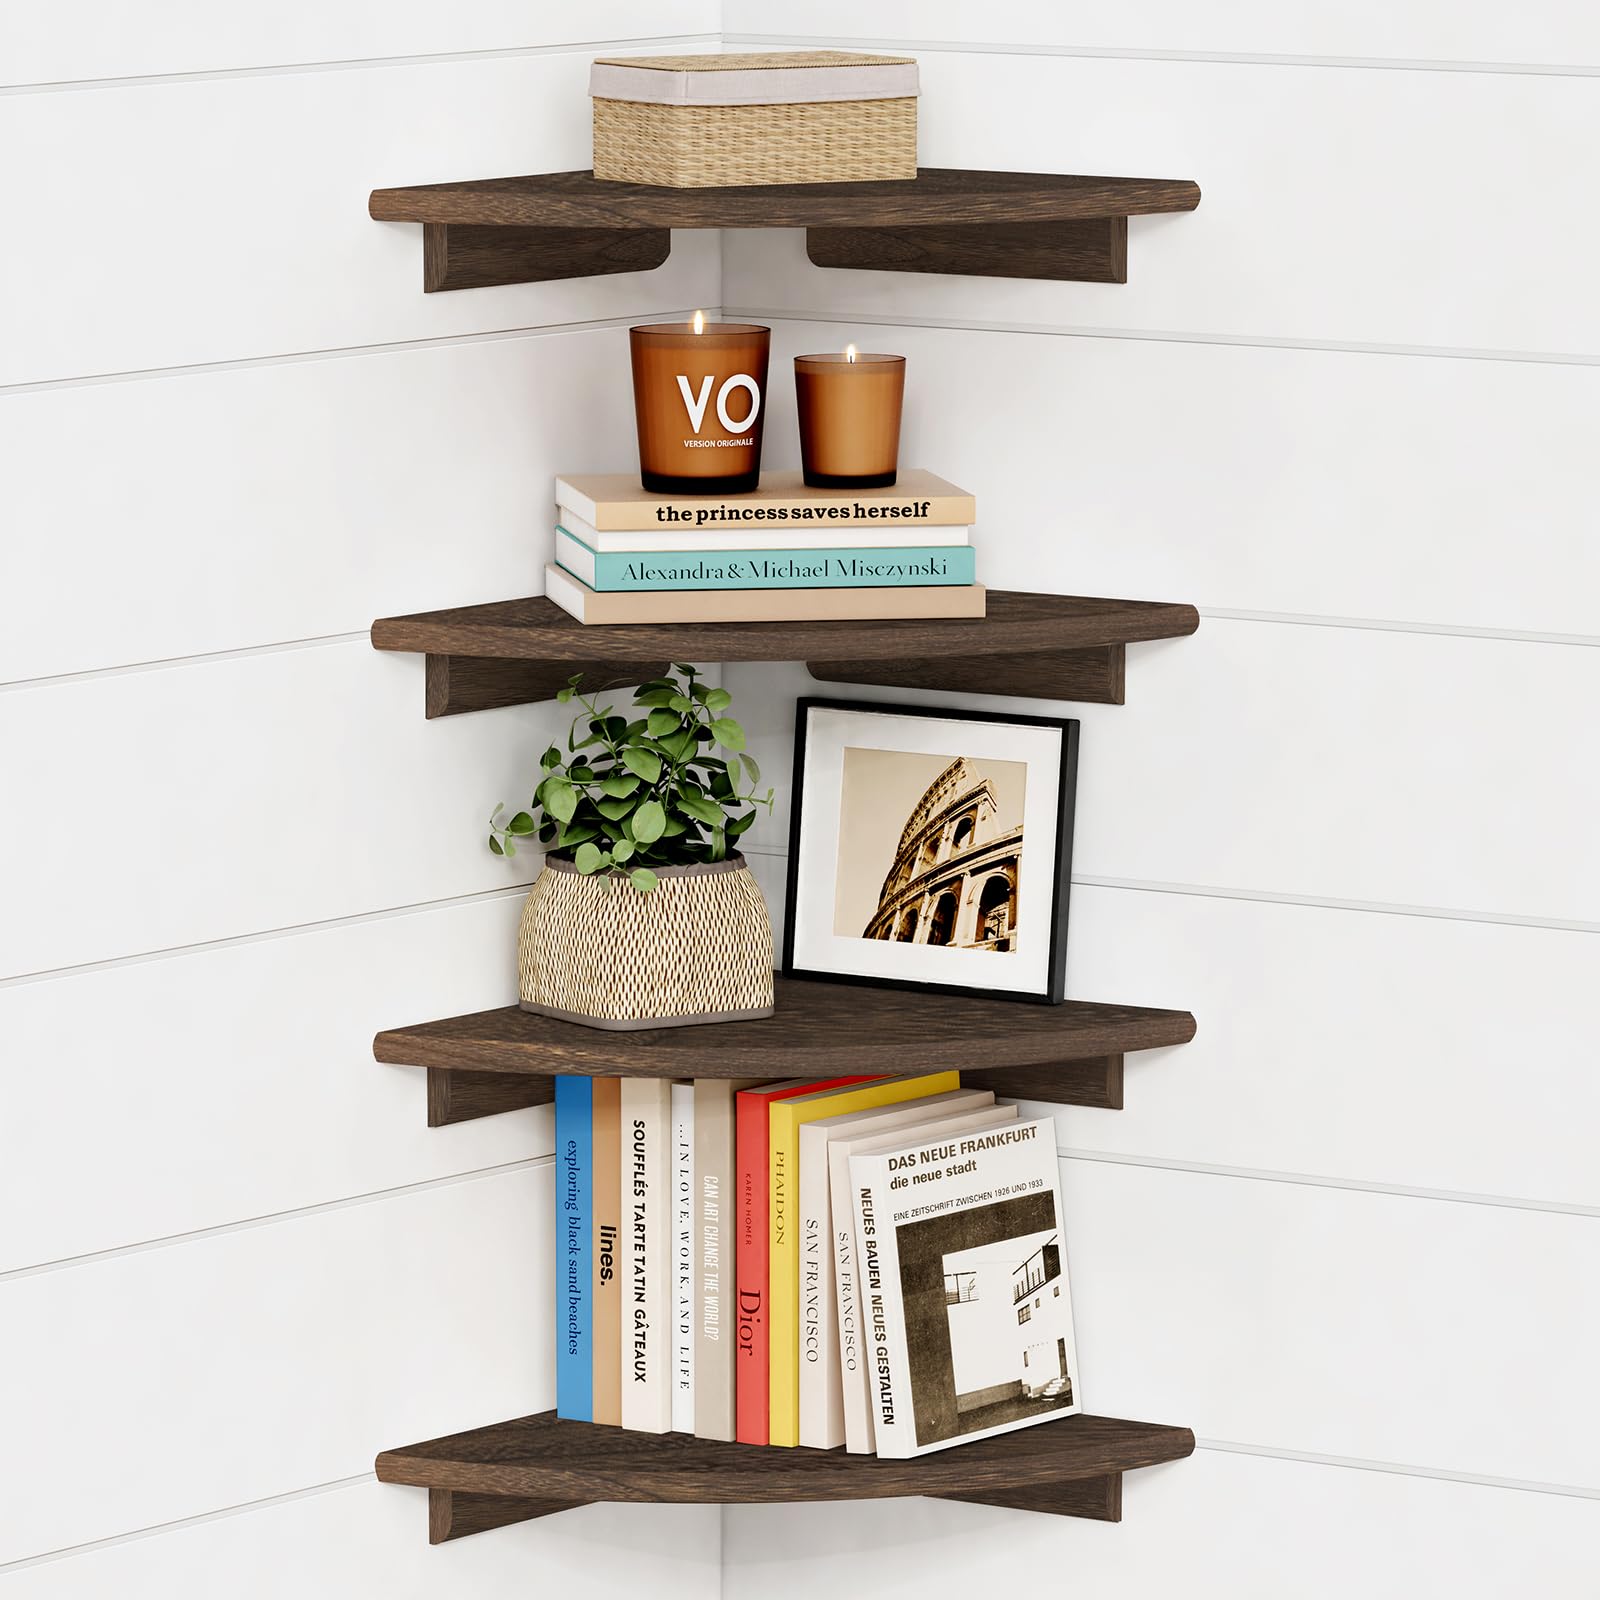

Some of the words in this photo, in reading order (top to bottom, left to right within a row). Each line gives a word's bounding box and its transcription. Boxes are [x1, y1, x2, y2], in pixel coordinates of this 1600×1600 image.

[676, 374, 760, 434] VO
[656, 506, 692, 522] the
[696, 505, 788, 526] princess
[791, 507, 850, 520] saves
[853, 502, 931, 519] herself
[622, 561, 724, 581] Alexandra
[728, 563, 744, 578] &
[749, 559, 828, 578] Michael
[837, 557, 947, 582] Misczynski
[633, 1120, 648, 1197] SOUFFLÉS
[888, 1154, 916, 1171] DAS
[920, 1145, 957, 1164] NEUE
[960, 1126, 1037, 1155] FRANKFURT
[564, 1140, 581, 1211] exploring
[703, 1175, 719, 1199] CAN
[890, 1176, 909, 1190] die
[912, 1169, 942, 1185] neue
[946, 1159, 977, 1177] stadt
[703, 1200, 719, 1222] ART
[776, 1151, 785, 1245] PHAIDON
[860, 1188, 876, 1236] NEUES
[893, 1211, 910, 1222] EINE
[911, 1199, 954, 1218] ZEITSCHRIFT
[955, 1191, 993, 1207] ZWISCHEN
[994, 1186, 1010, 1198] 1926
[1011, 1182, 1027, 1194] UND
[1028, 1178, 1044, 1189] 1933
[568, 1216, 582, 1256] black
[634, 1203, 646, 1252] TARTE
[704, 1225, 719, 1270] CHANGE
[806, 1219, 818, 1254] SAN
[838, 1232, 850, 1265] SAN
[568, 1259, 582, 1294] sand
[600, 1225, 617, 1286] lines.
[865, 1240, 881, 1289] BAUEN
[634, 1256, 646, 1303] TATIN
[704, 1273, 719, 1293] THE
[568, 1296, 582, 1356] beaches
[680, 1296, 690, 1334] AND
[704, 1296, 719, 1341] WORLD?
[739, 1288, 761, 1357] Dior
[806, 1261, 819, 1363] FRANCISCO
[841, 1272, 857, 1371] FRANCISCO
[871, 1295, 887, 1342] NEUES
[634, 1309, 650, 1383] GÂTEAUX
[680, 1346, 690, 1390] LIFE
[876, 1347, 895, 1425] GESTALTEN
